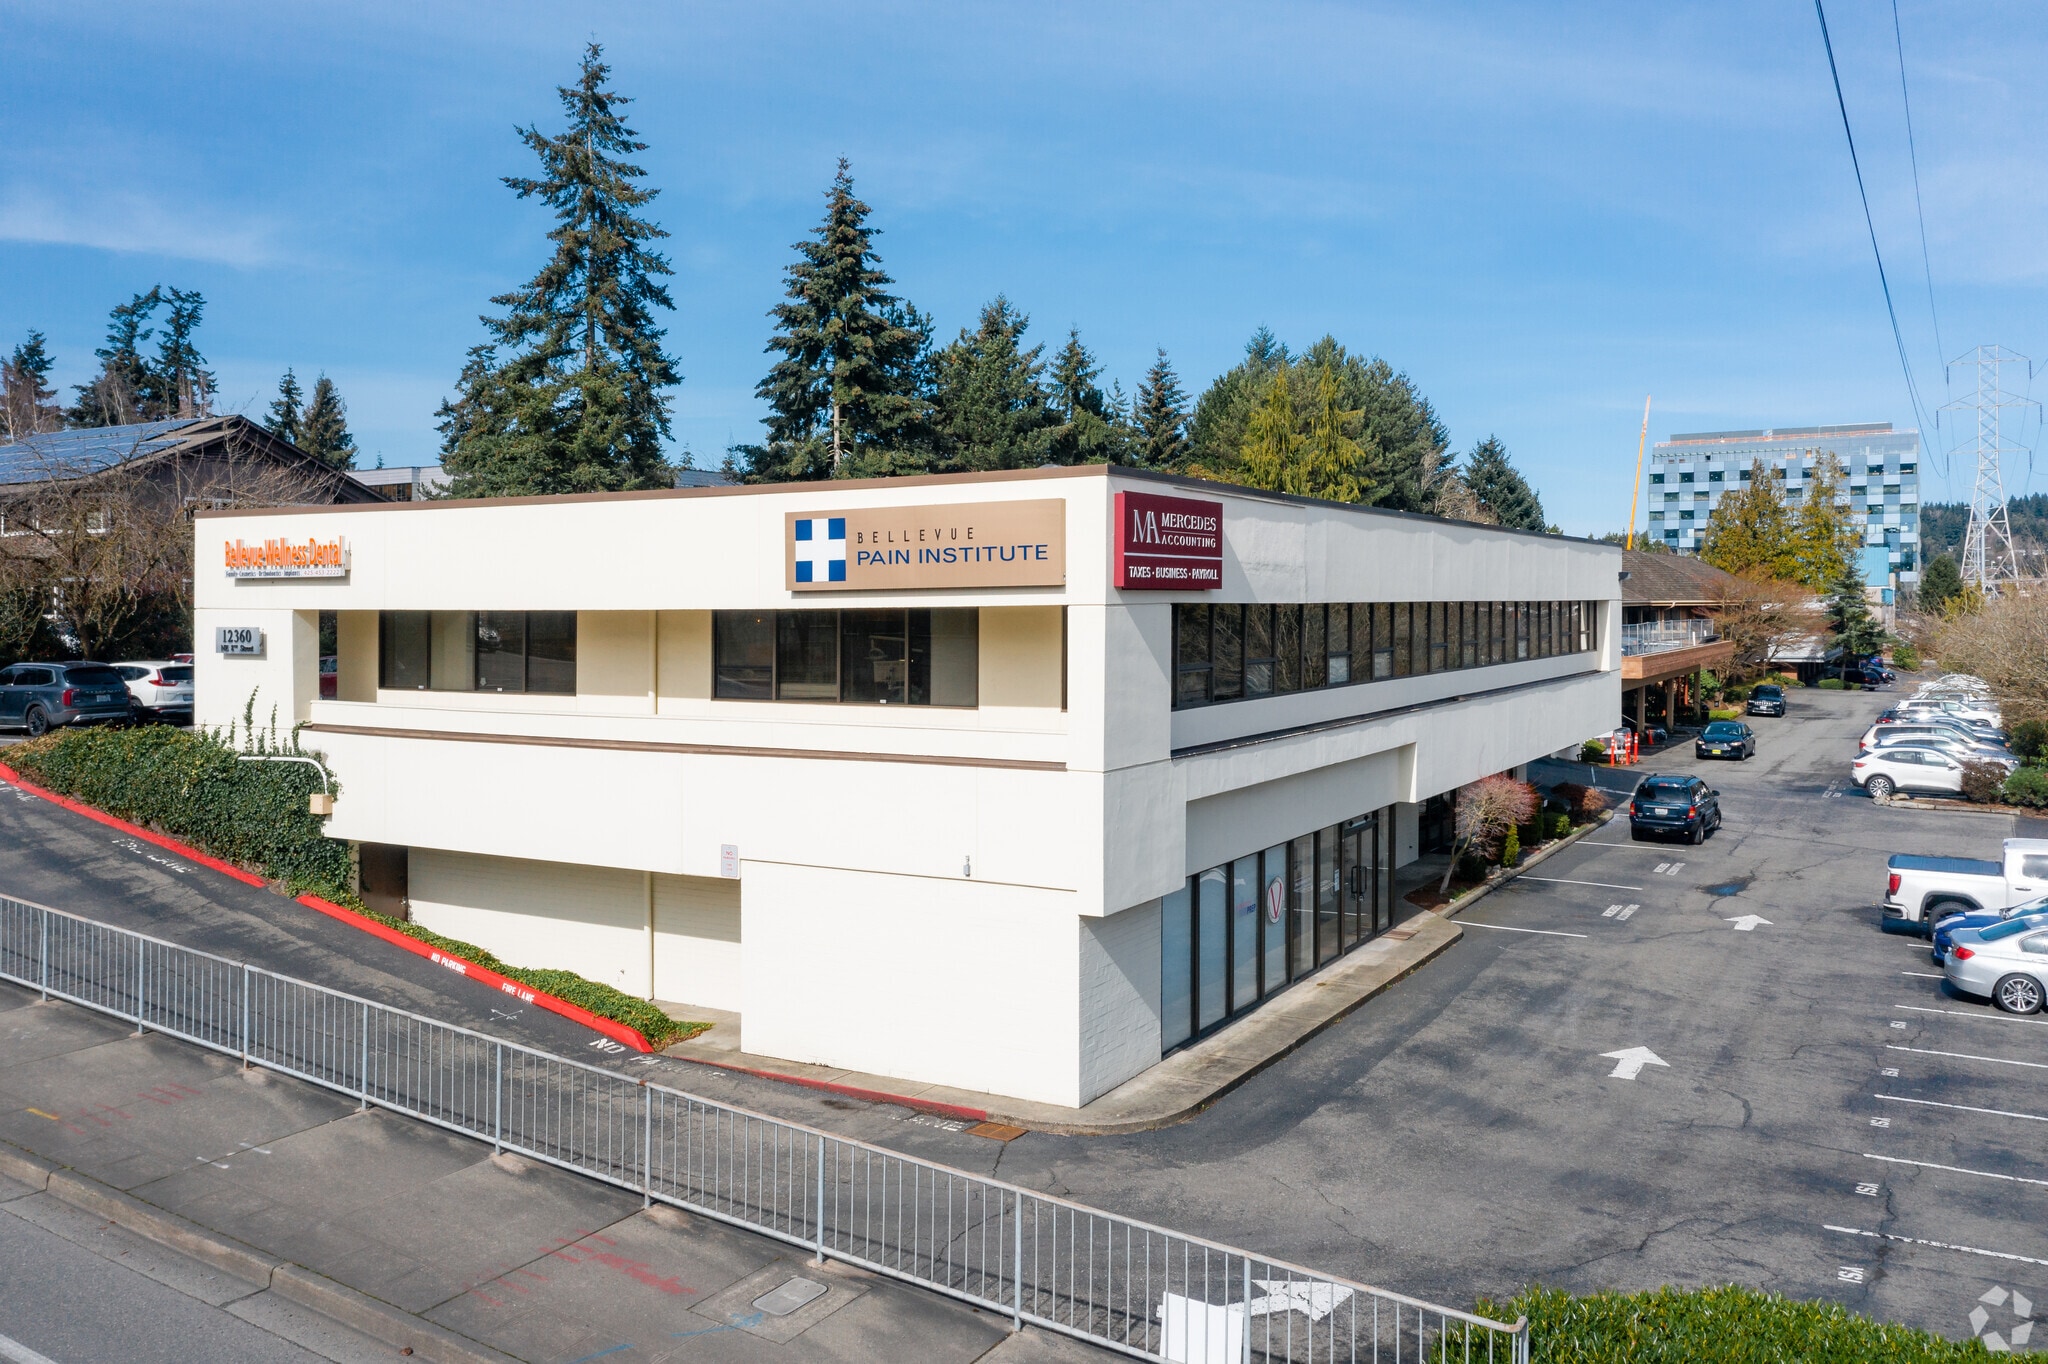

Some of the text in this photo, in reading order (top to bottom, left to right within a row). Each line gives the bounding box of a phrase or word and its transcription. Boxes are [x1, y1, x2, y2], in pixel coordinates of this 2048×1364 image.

[1161, 512, 1217, 532] MERCEDES
[857, 527, 974, 544] BELLEVUE
[1161, 534, 1216, 549] ACCOUNTING
[225, 535, 343, 567] Bellevue Wellness Dental
[857, 544, 1049, 566] PAIN INSTITUTE
[1128, 566, 1219, 580] TAXES BUSINESS PAYROLL
[222, 629, 252, 643] 12360
[431, 952, 467, 975] NO PARKING
[501, 982, 517, 996] FIRE
[589, 1038, 626, 1054] NO
